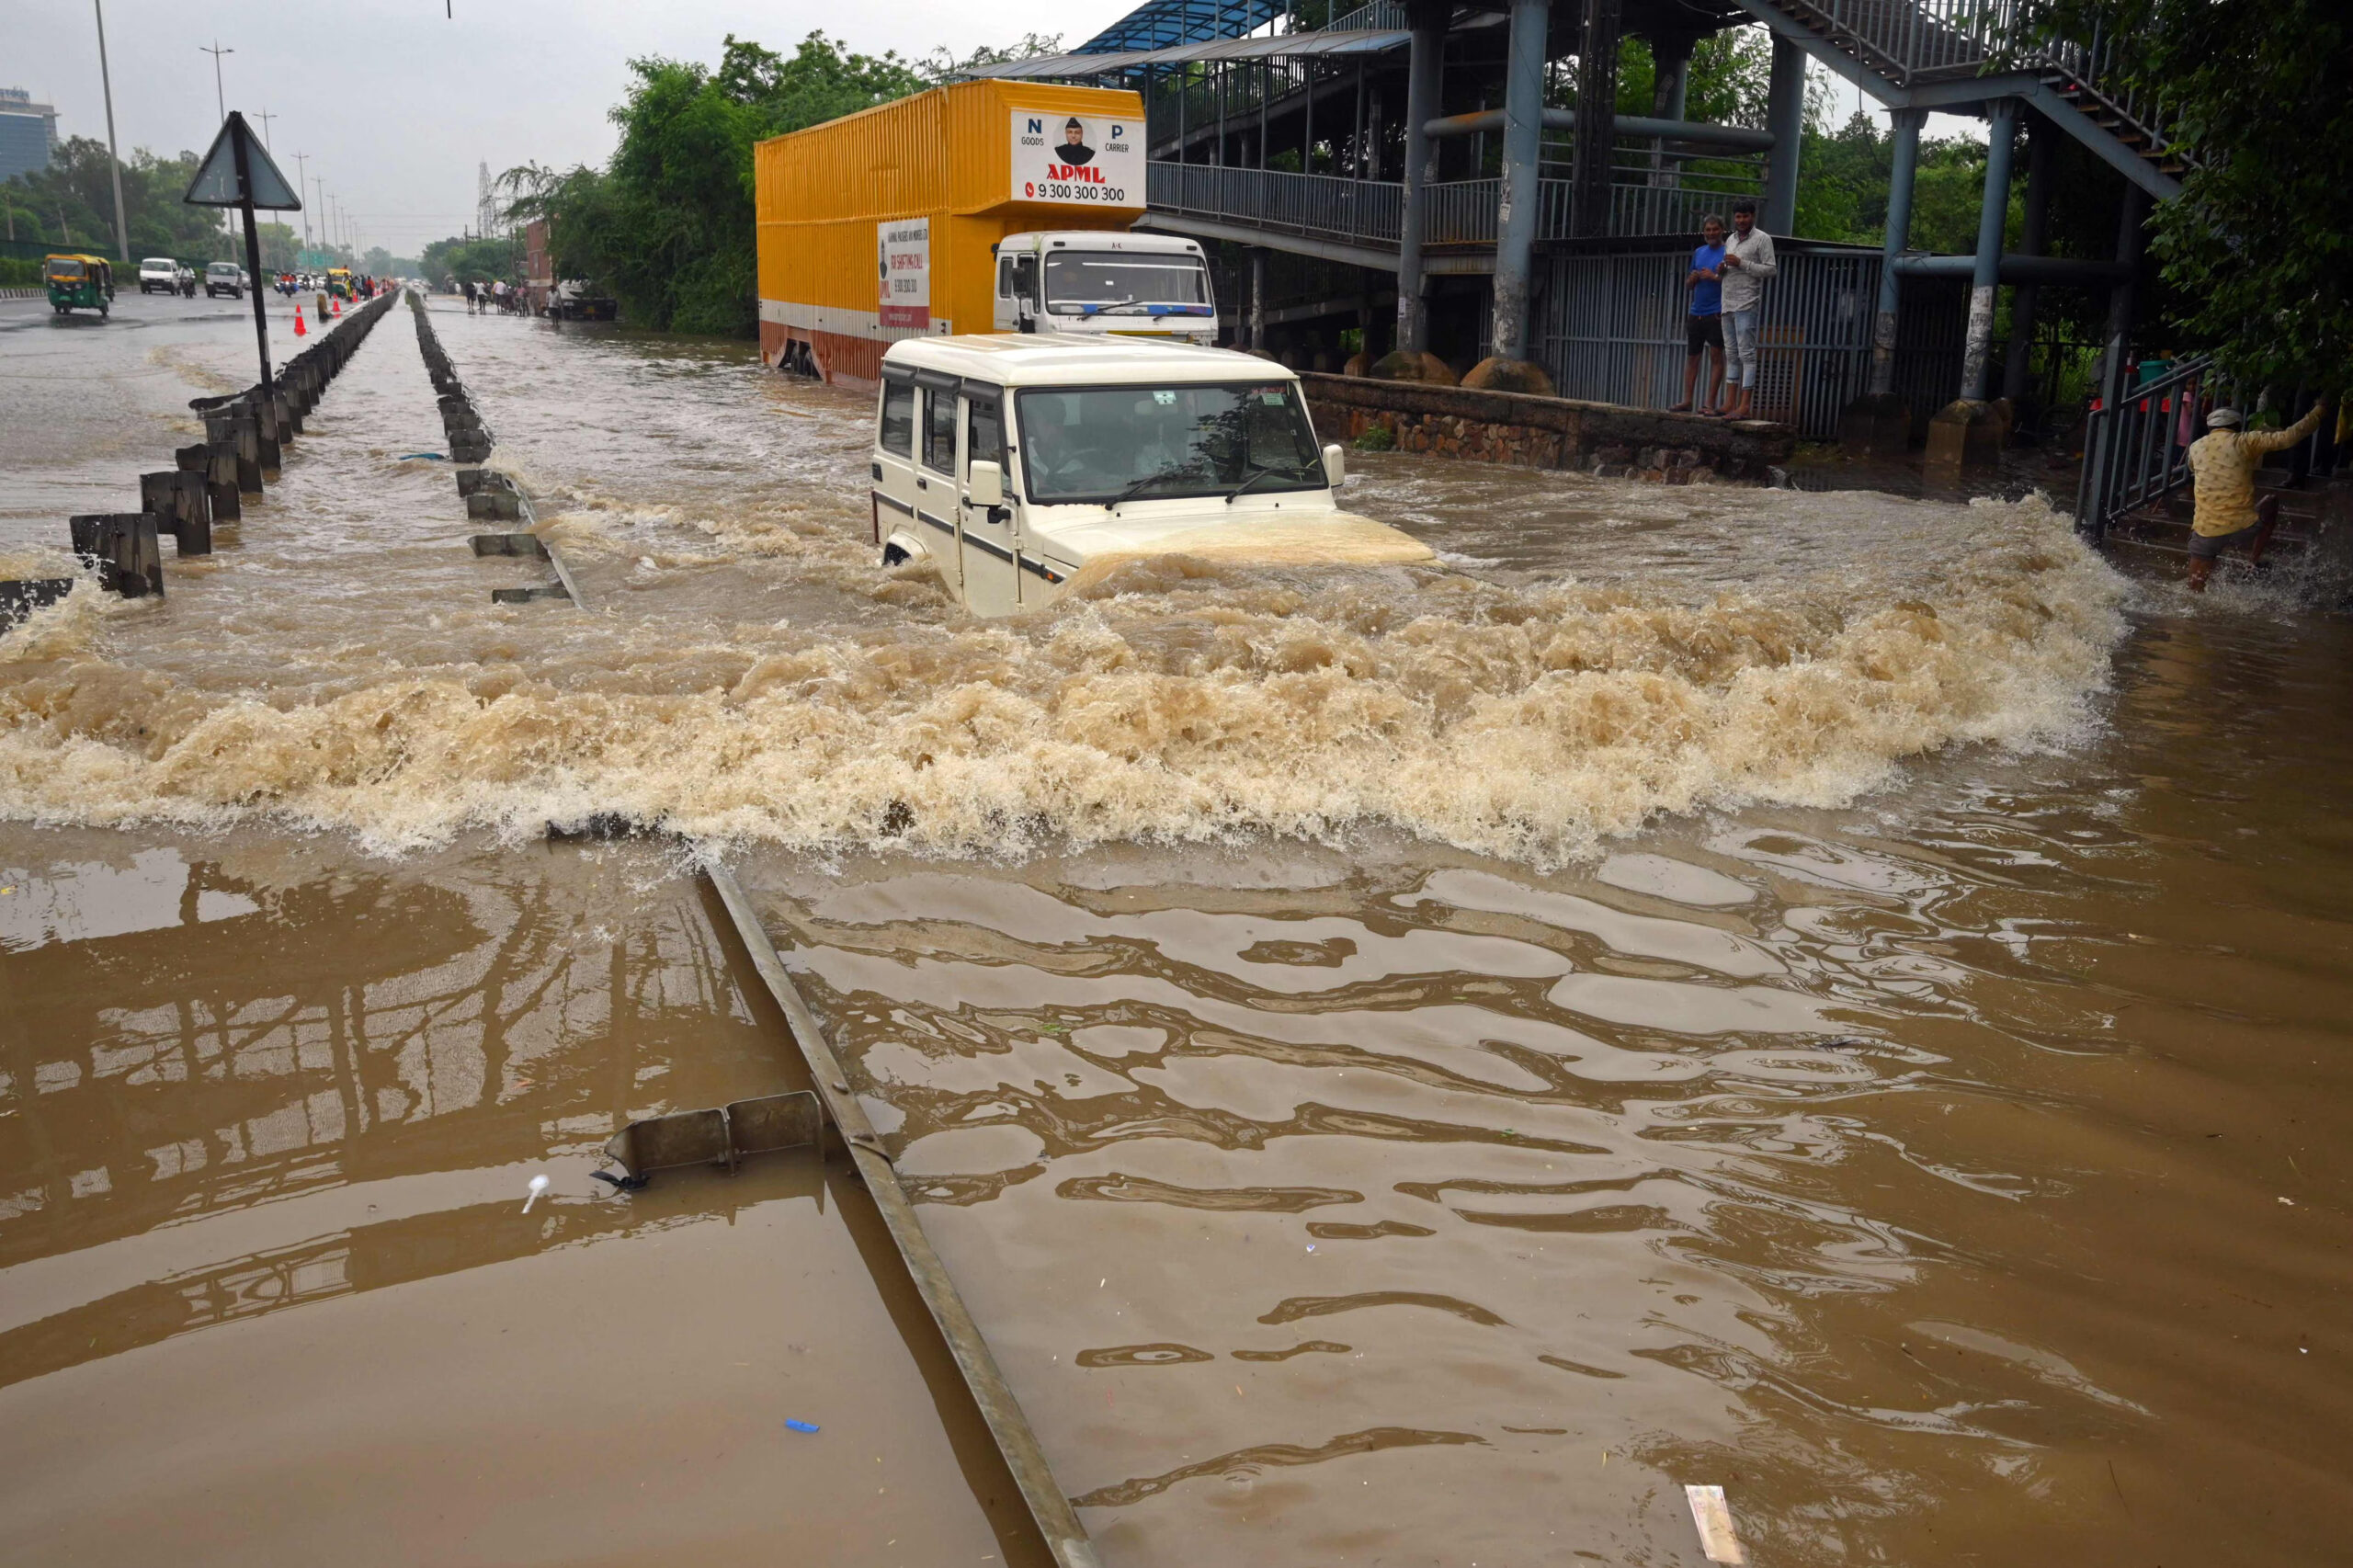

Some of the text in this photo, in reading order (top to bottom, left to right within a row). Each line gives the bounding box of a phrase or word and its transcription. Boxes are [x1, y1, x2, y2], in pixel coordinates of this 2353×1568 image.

[1028, 119, 1041, 134] N
[1111, 124, 1123, 140] P
[1021, 136, 1044, 147] GOODS
[1105, 142, 1130, 153] CARRIER
[1047, 164, 1106, 184] APML
[1049, 184, 1072, 199] 300
[1074, 185, 1098, 200] 300
[1101, 187, 1125, 201] 300
